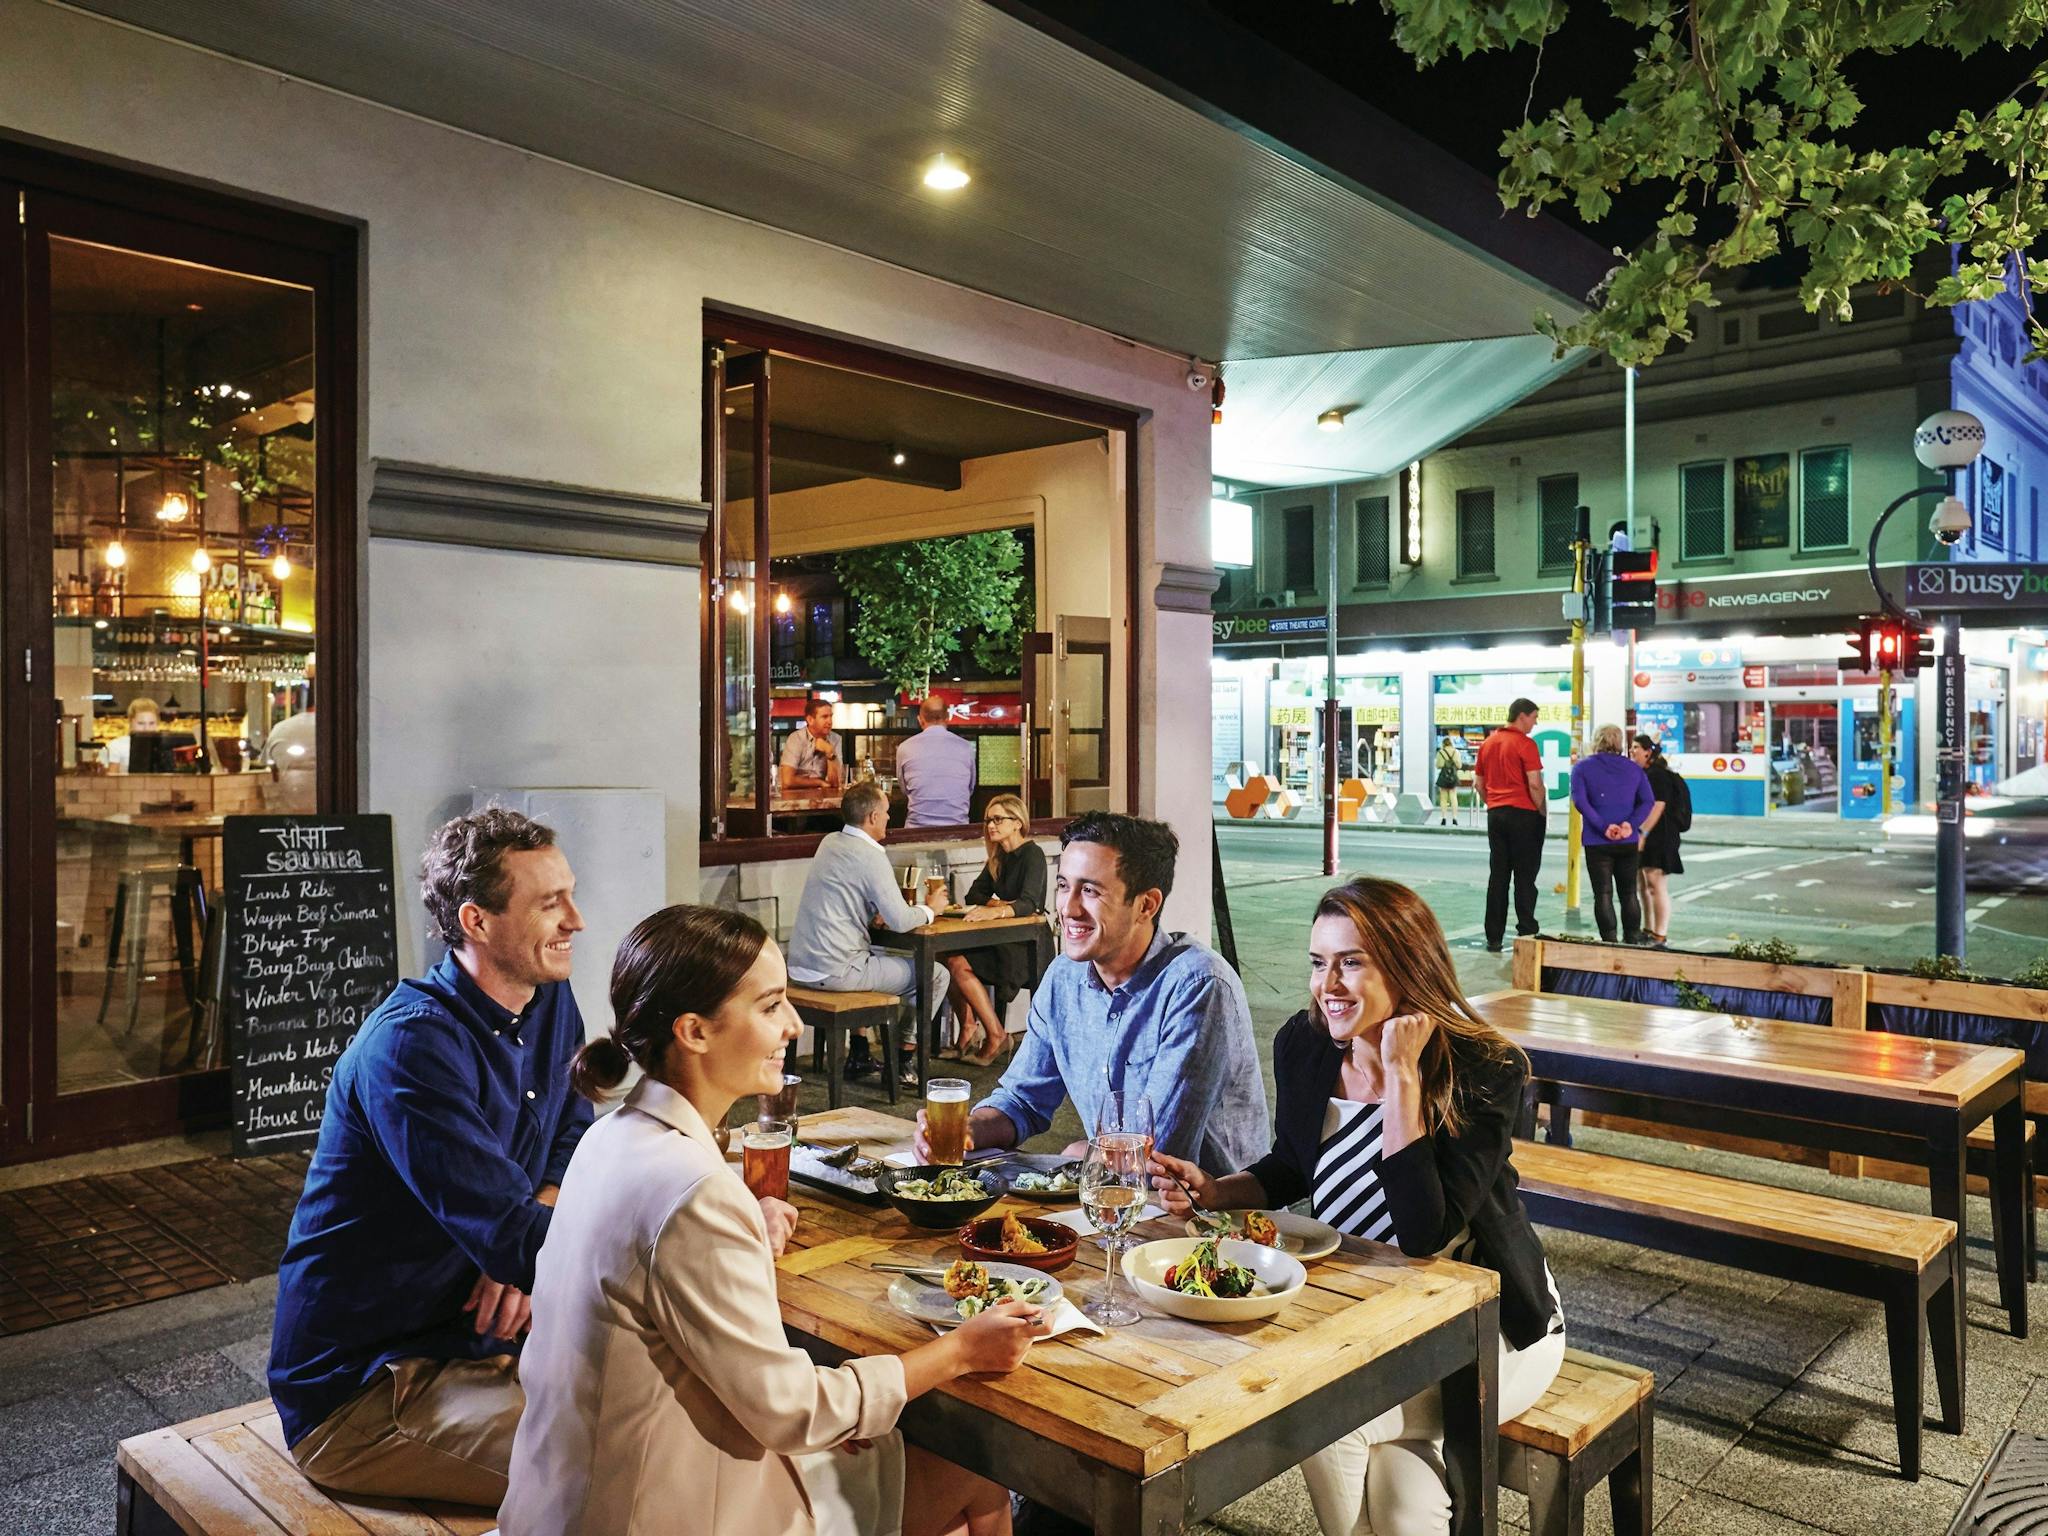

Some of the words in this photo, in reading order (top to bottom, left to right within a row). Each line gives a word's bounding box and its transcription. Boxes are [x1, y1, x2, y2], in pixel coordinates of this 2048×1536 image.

[1708, 589, 1832, 608] NEWSAGENCY
[1275, 621, 1289, 631] STATE
[1289, 620, 1308, 630] THEATRE
[1309, 619, 1327, 629] CENTRE
[1944, 656, 1956, 747] EMERGENCY
[1277, 708, 1306, 724] 药房
[1356, 707, 1400, 723] 直邮中国
[245, 883, 290, 901] Lamb
[300, 880, 336, 898] Ribs
[297, 904, 327, 928] Beef
[330, 902, 378, 922] Samosa
[242, 933, 298, 957] Bheja
[301, 929, 335, 952] Fry
[243, 957, 294, 986] Bang
[294, 953, 336, 981] Bang
[337, 945, 385, 970] Chicken
[244, 984, 305, 1010] Winter
[307, 980, 338, 1007] Veg
[315, 1006, 356, 1029] BBQ
[246, 1043, 297, 1067] Lamb
[303, 1037, 341, 1059] Neck
[246, 1072, 319, 1101] Mountain
[246, 1106, 298, 1132] House
